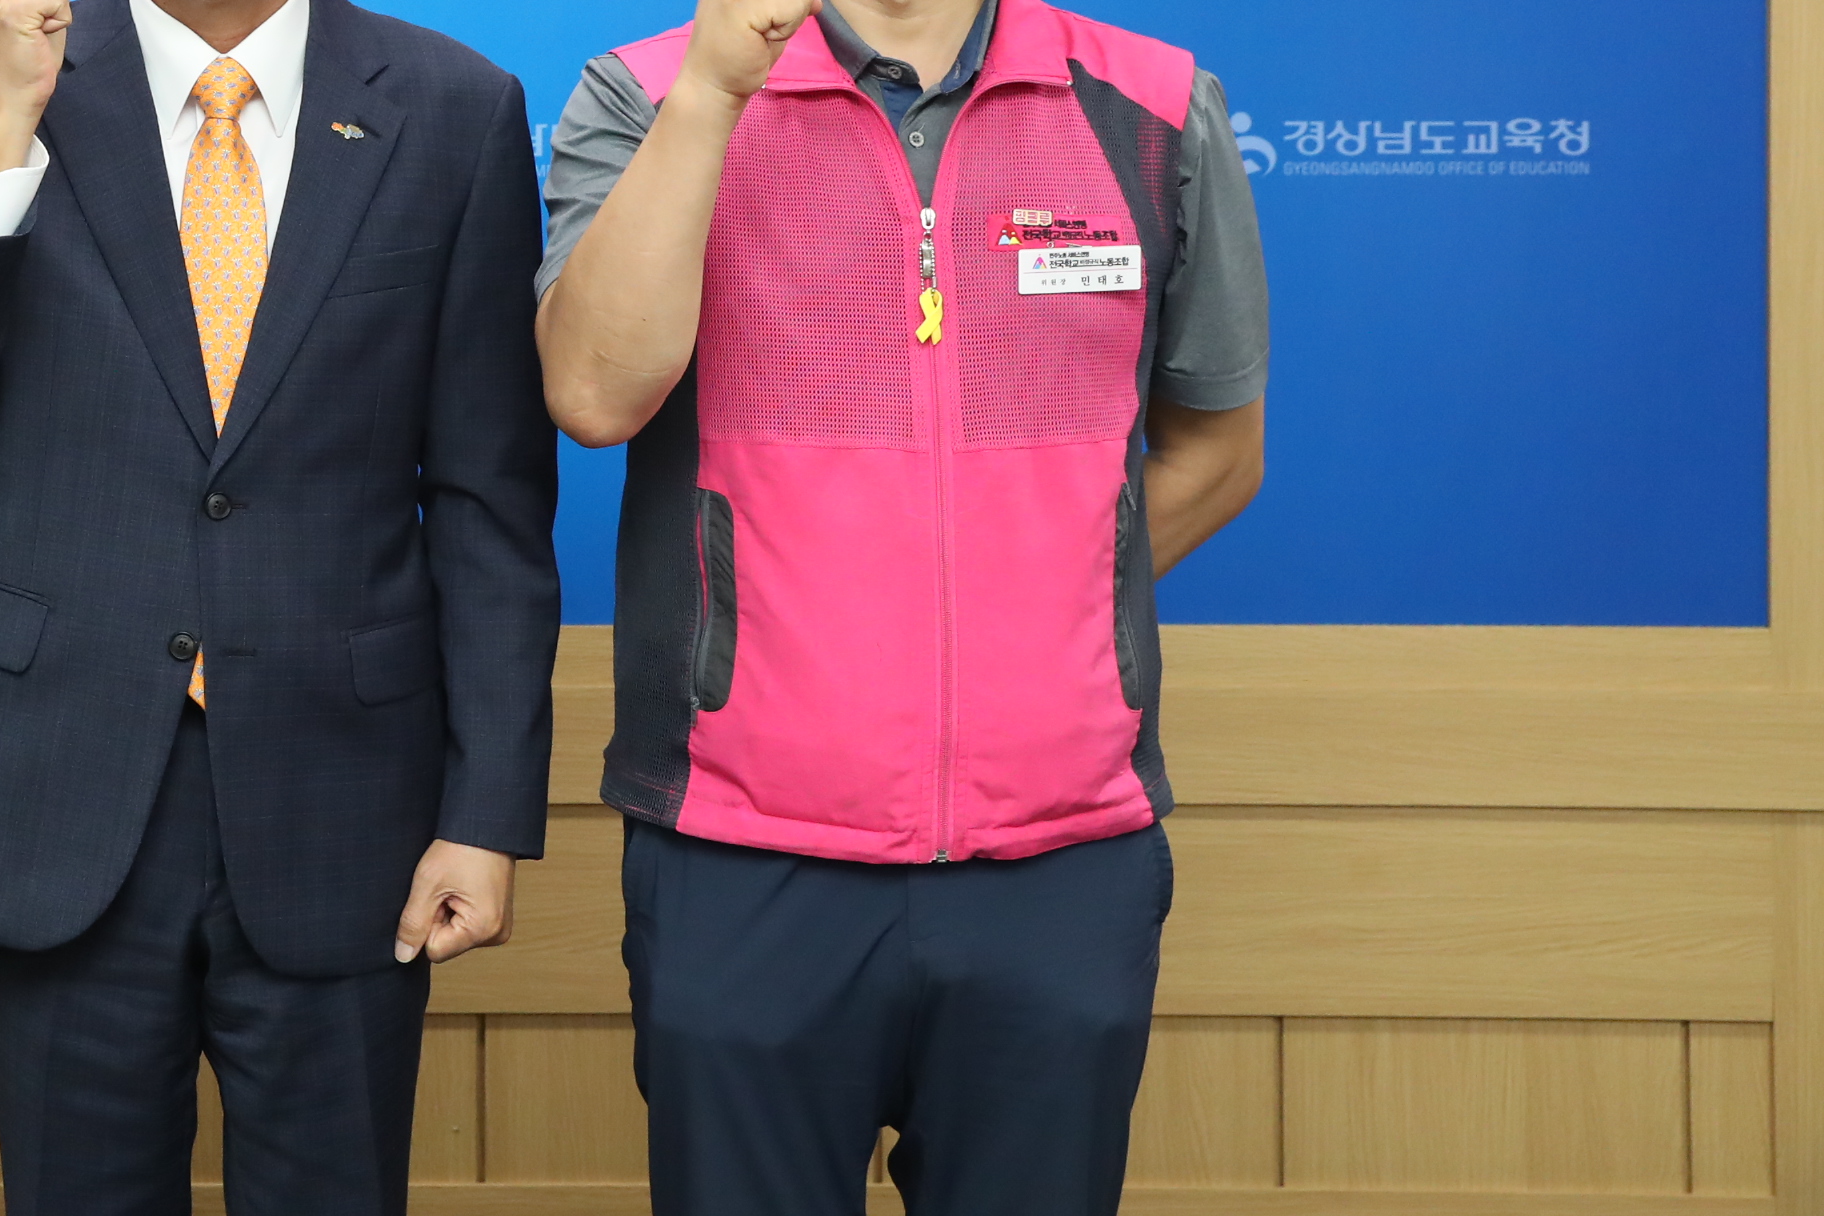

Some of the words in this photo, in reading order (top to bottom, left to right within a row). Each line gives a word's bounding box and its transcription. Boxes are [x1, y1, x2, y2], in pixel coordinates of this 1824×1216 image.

[1283, 118, 1590, 156] 경상남도교육청
[1283, 161, 1435, 176] GYEONGSANGNAMDO
[1438, 161, 1484, 175] OFFICE
[1488, 161, 1506, 175] OF
[1509, 160, 1590, 175] EDUCATION
